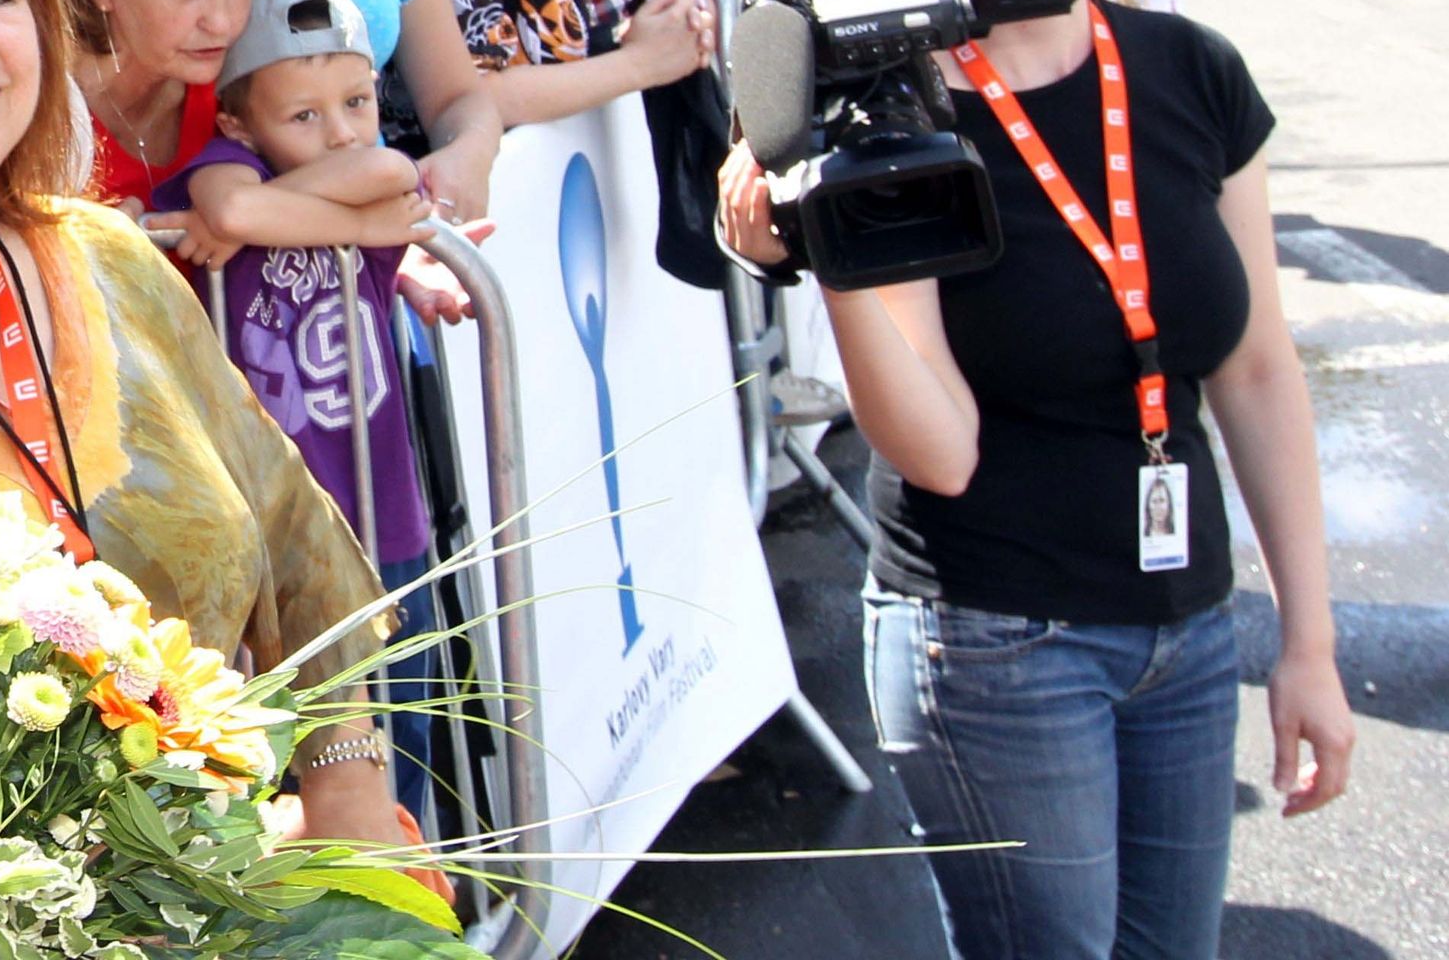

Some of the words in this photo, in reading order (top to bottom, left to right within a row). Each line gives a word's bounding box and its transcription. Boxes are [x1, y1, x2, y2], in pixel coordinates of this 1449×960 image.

[834, 21, 880, 37] SONY
[605, 672, 650, 751] Karlovy
[648, 632, 676, 681] Vary
[668, 635, 719, 708] Festival
